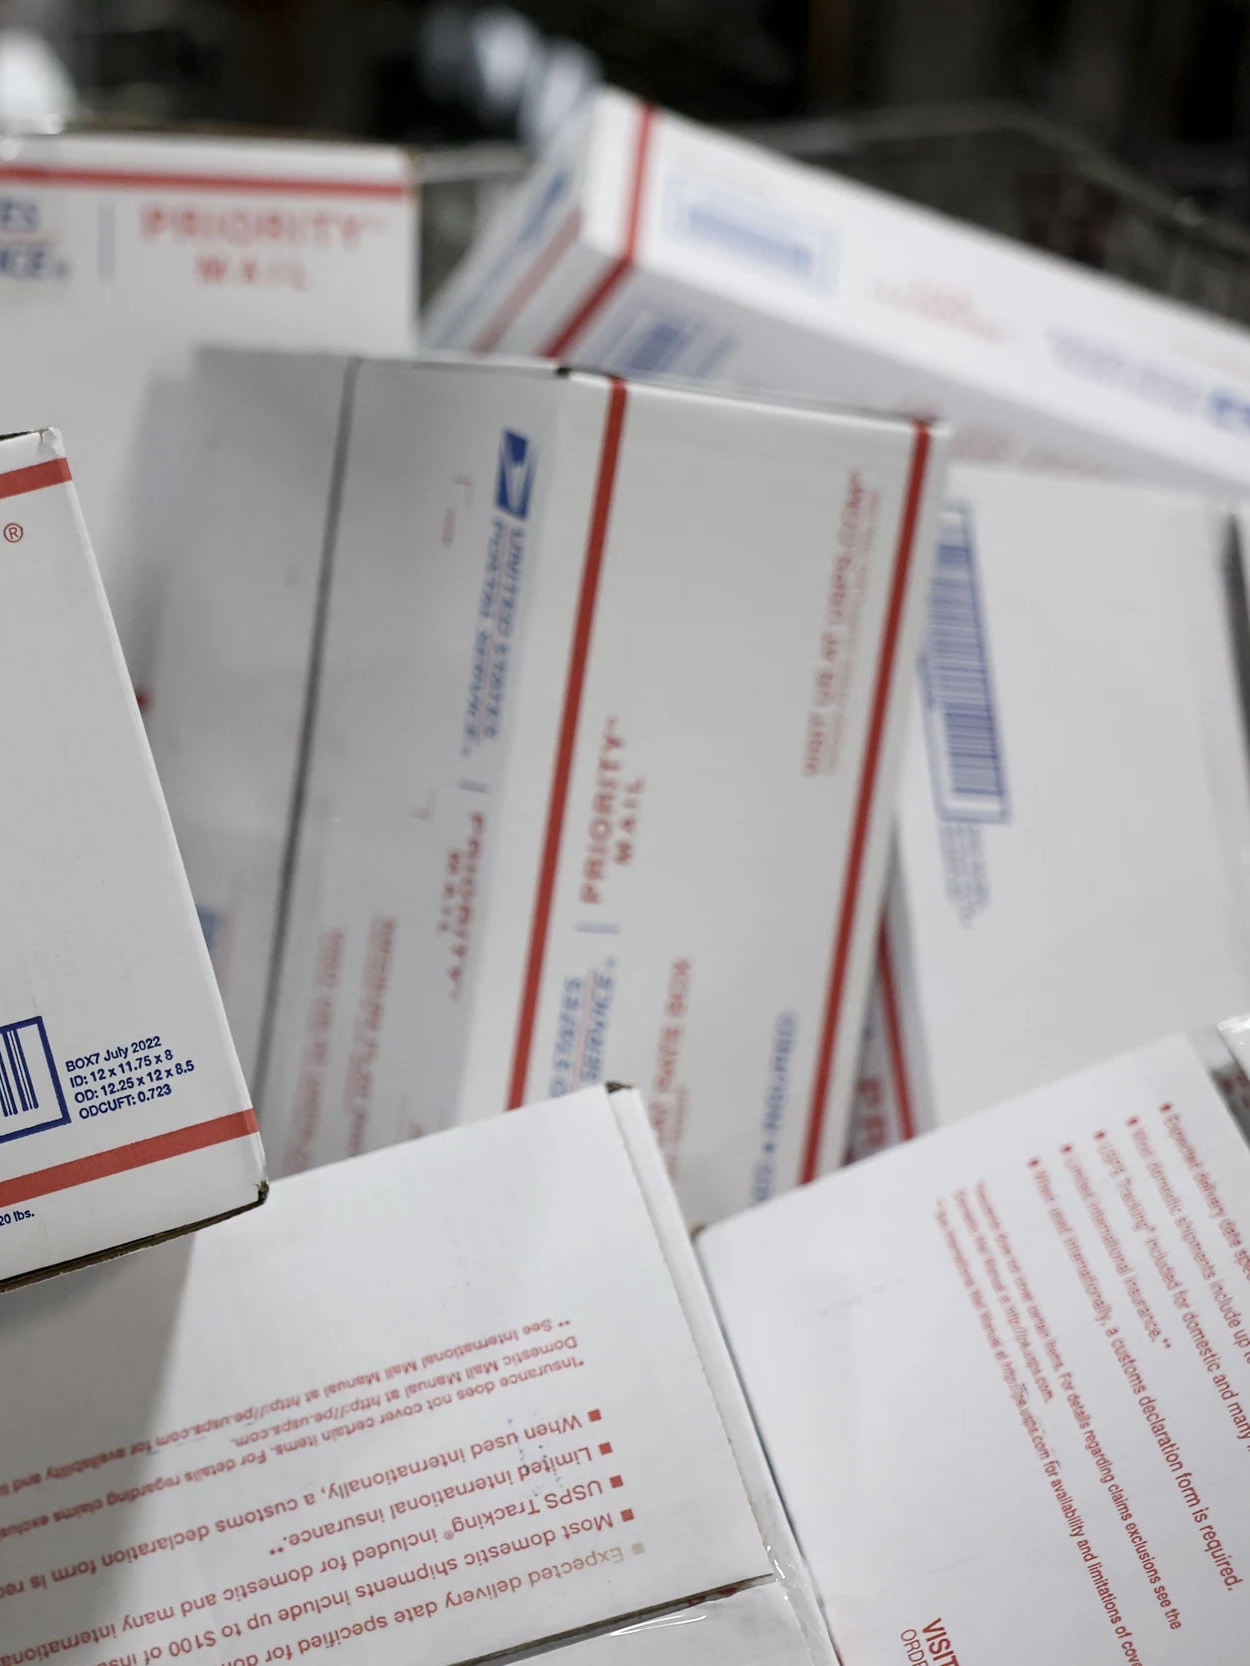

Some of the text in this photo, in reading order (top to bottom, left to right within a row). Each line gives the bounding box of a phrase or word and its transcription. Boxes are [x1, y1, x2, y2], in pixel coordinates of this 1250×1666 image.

[65, 1035, 162, 1072] BOX7 July 2022
[69, 1049, 173, 1088] ID: 12 x 11.75 x 8
[74, 1059, 195, 1103] OD: 12.25 x 12 x 8.5
[78, 1083, 172, 1120] ODCUFT: 0.723
[12, 1209, 34, 1221] lbs.
[421, 1330, 518, 1368] International
[502, 1335, 577, 1365] Domestic
[384, 1360, 417, 1379] Mail
[465, 1360, 499, 1379] Mail
[1182, 1312, 1249, 1439] domestic and many
[323, 1371, 380, 1397] Manual
[384, 1388, 400, 1402] at
[404, 1371, 462, 1397] Manual
[456, 1380, 495, 1400] does
[379, 1402, 422, 1424] cover
[425, 1393, 452, 1410] not
[321, 1417, 374, 1441] certain
[523, 1415, 582, 1448] When
[1138, 1396, 1182, 1471] declaration
[240, 1449, 266, 1465] For
[270, 1435, 318, 1455] items.
[470, 1432, 522, 1459] used
[183, 1458, 236, 1481] details
[321, 1449, 464, 1498] internationally,
[517, 1447, 591, 1480] Limited
[302, 1492, 315, 1505] a
[390, 1471, 512, 1518] international
[544, 1480, 602, 1509] USPS
[1175, 1472, 1200, 1507] form
[215, 1498, 297, 1532] customs
[561, 1513, 613, 1539] Most
[1191, 1506, 1209, 1523] is
[1084, 1429, 1114, 1483] regarding
[1107, 1483, 1132, 1521] claims
[1125, 1522, 1160, 1583] exclusions
[1153, 1585, 1171, 1607] see
[1164, 1608, 1181, 1629] the
[101, 1525, 209, 1566] declaration
[352, 1528, 437, 1566] included
[464, 1529, 555, 1565] domestic
[1050, 1479, 1084, 1536] availability
[1076, 1539, 1098, 1562] and
[1087, 1562, 1121, 1623] limitations
[1114, 1625, 1132, 1638] of
[1199, 1524, 1242, 1590] required.
[51, 1560, 96, 1581] form
[319, 1555, 347, 1572] for
[355, 1558, 457, 1597] shipments
[527, 1547, 622, 1586] Expected
[29, 1575, 46, 1588] is
[223, 1565, 313, 1600] domestic
[445, 1576, 521, 1607] delivery
[122, 1606, 174, 1631] many
[180, 1593, 216, 1617] and
[278, 1590, 350, 1621] include
[394, 1601, 437, 1623] date
[221, 1622, 241, 1637] to
[246, 1613, 272, 1630] up
[297, 1615, 387, 1654] specified
[143, 1646, 162, 1665] of
[168, 1630, 216, 1656] $100
[264, 1644, 292, 1662] for
[921, 1617, 959, 1666] VISIT
